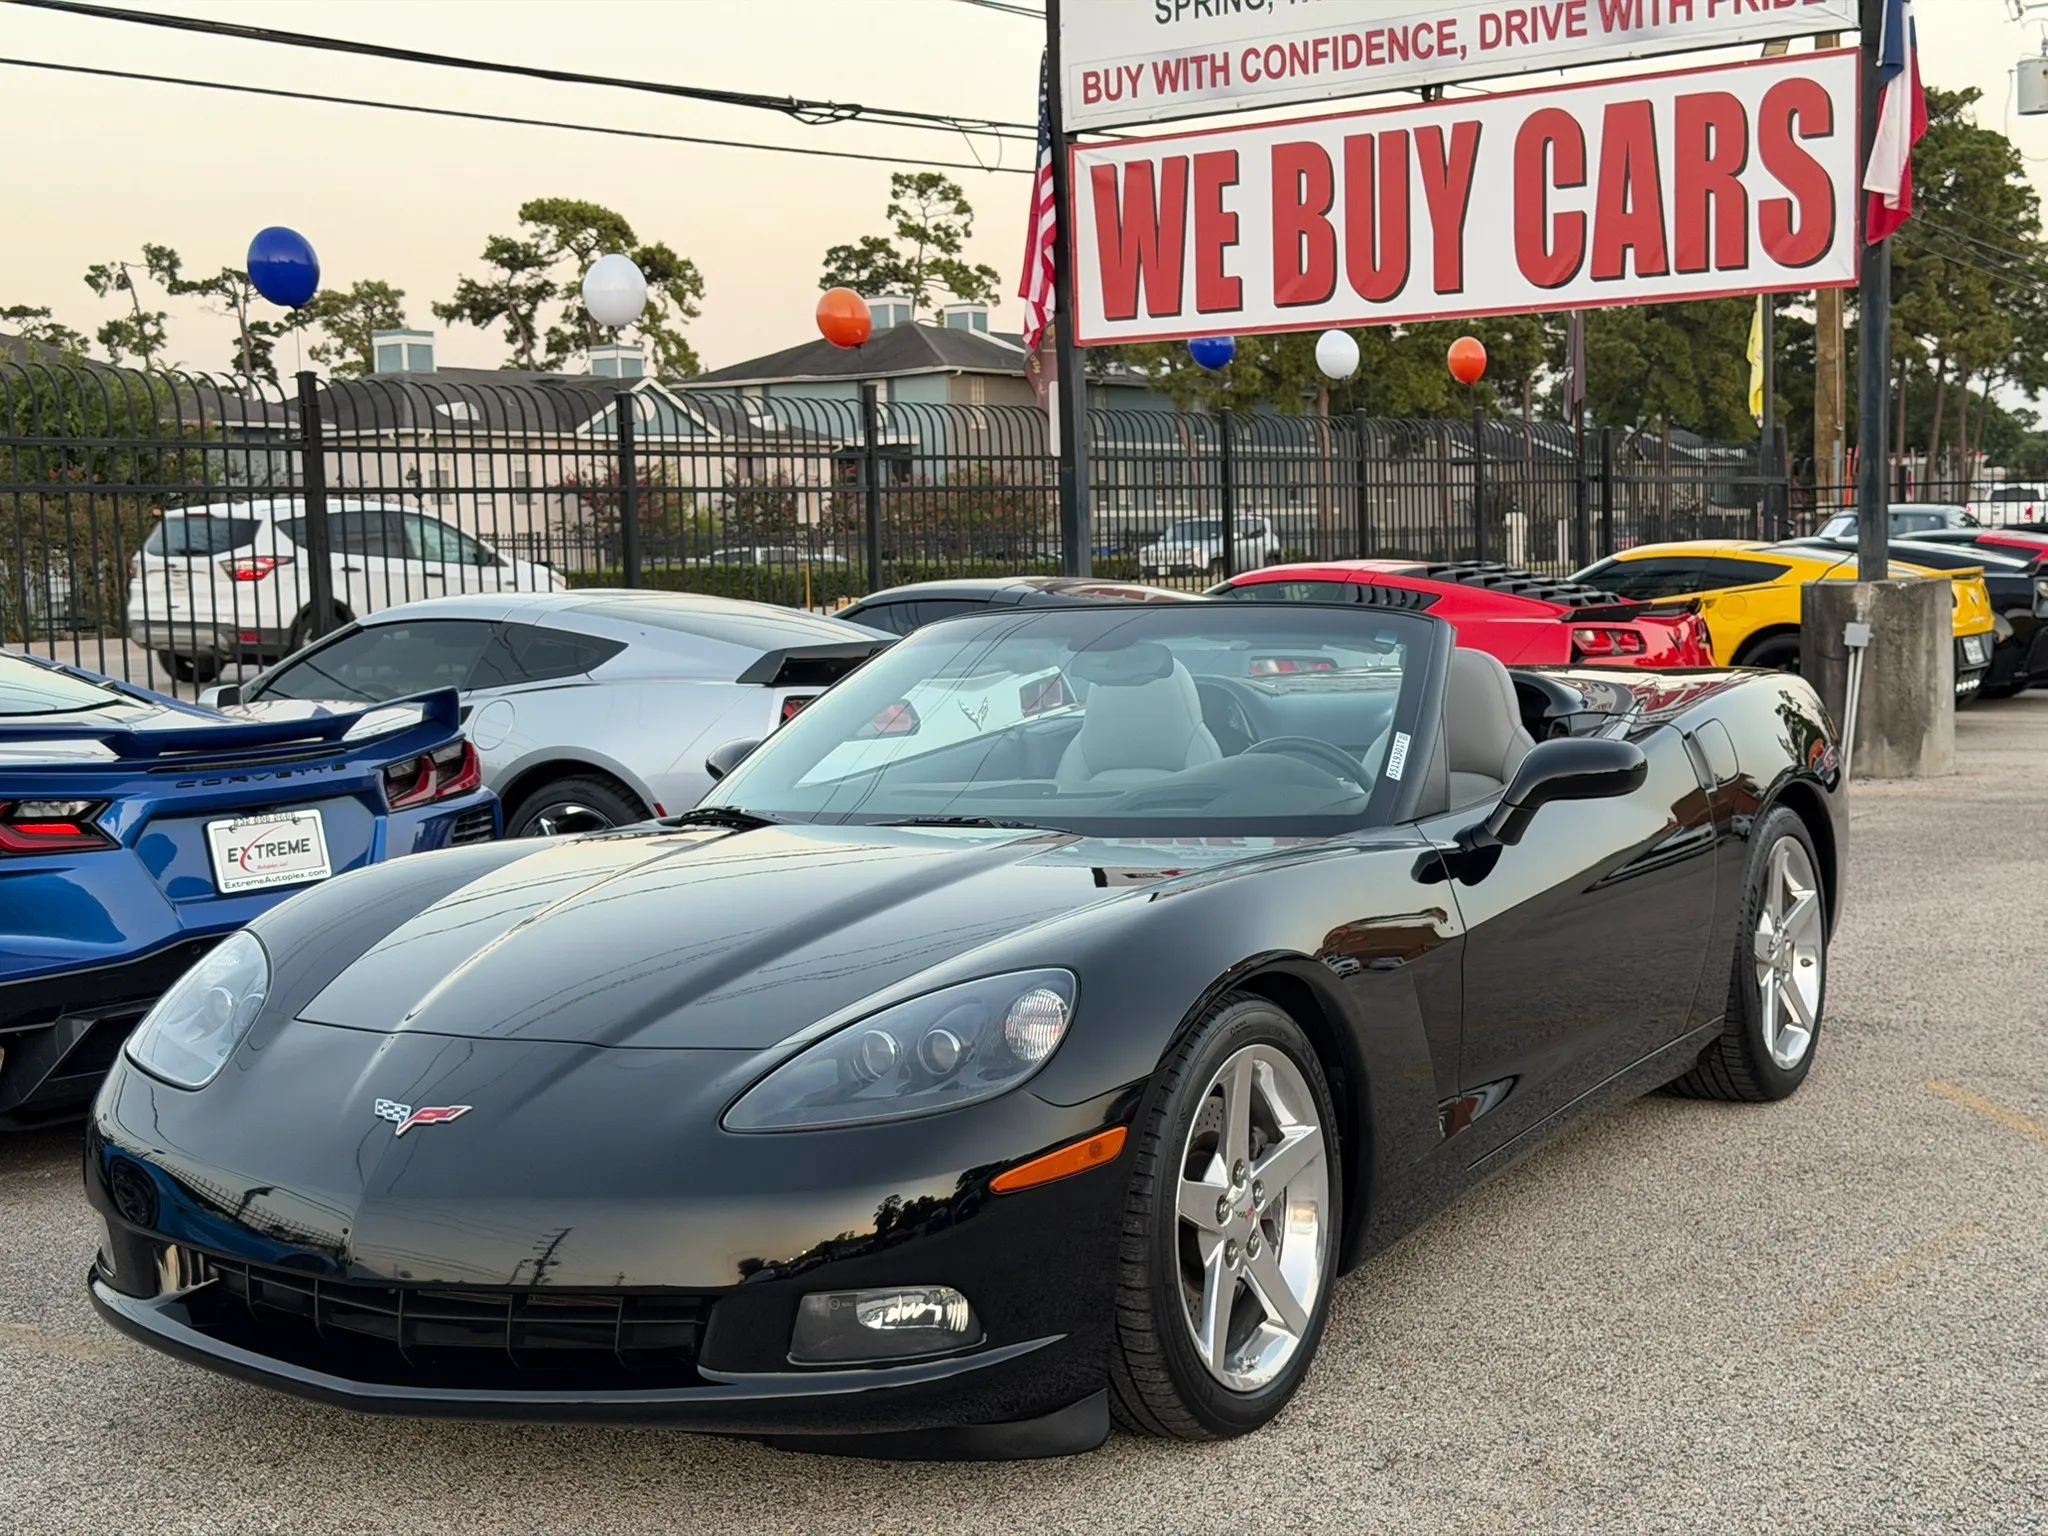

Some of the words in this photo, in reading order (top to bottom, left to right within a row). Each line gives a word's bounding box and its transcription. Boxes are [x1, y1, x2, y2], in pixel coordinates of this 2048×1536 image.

[1083, 64, 1144, 104] BUY
[1152, 51, 1230, 95] WITH
[1240, 19, 1468, 83] CONFIDENCE,
[1479, 0, 1588, 52] DRIVE
[1599, 0, 1694, 33] WITH
[1090, 149, 1243, 322] WE
[1271, 120, 1483, 309] BUY
[1513, 77, 1836, 289] CARS
[175, 763, 347, 789] CORVETTE
[227, 838, 311, 863] EXTREME
[224, 869, 328, 890] ExtremeAutoplex.com
